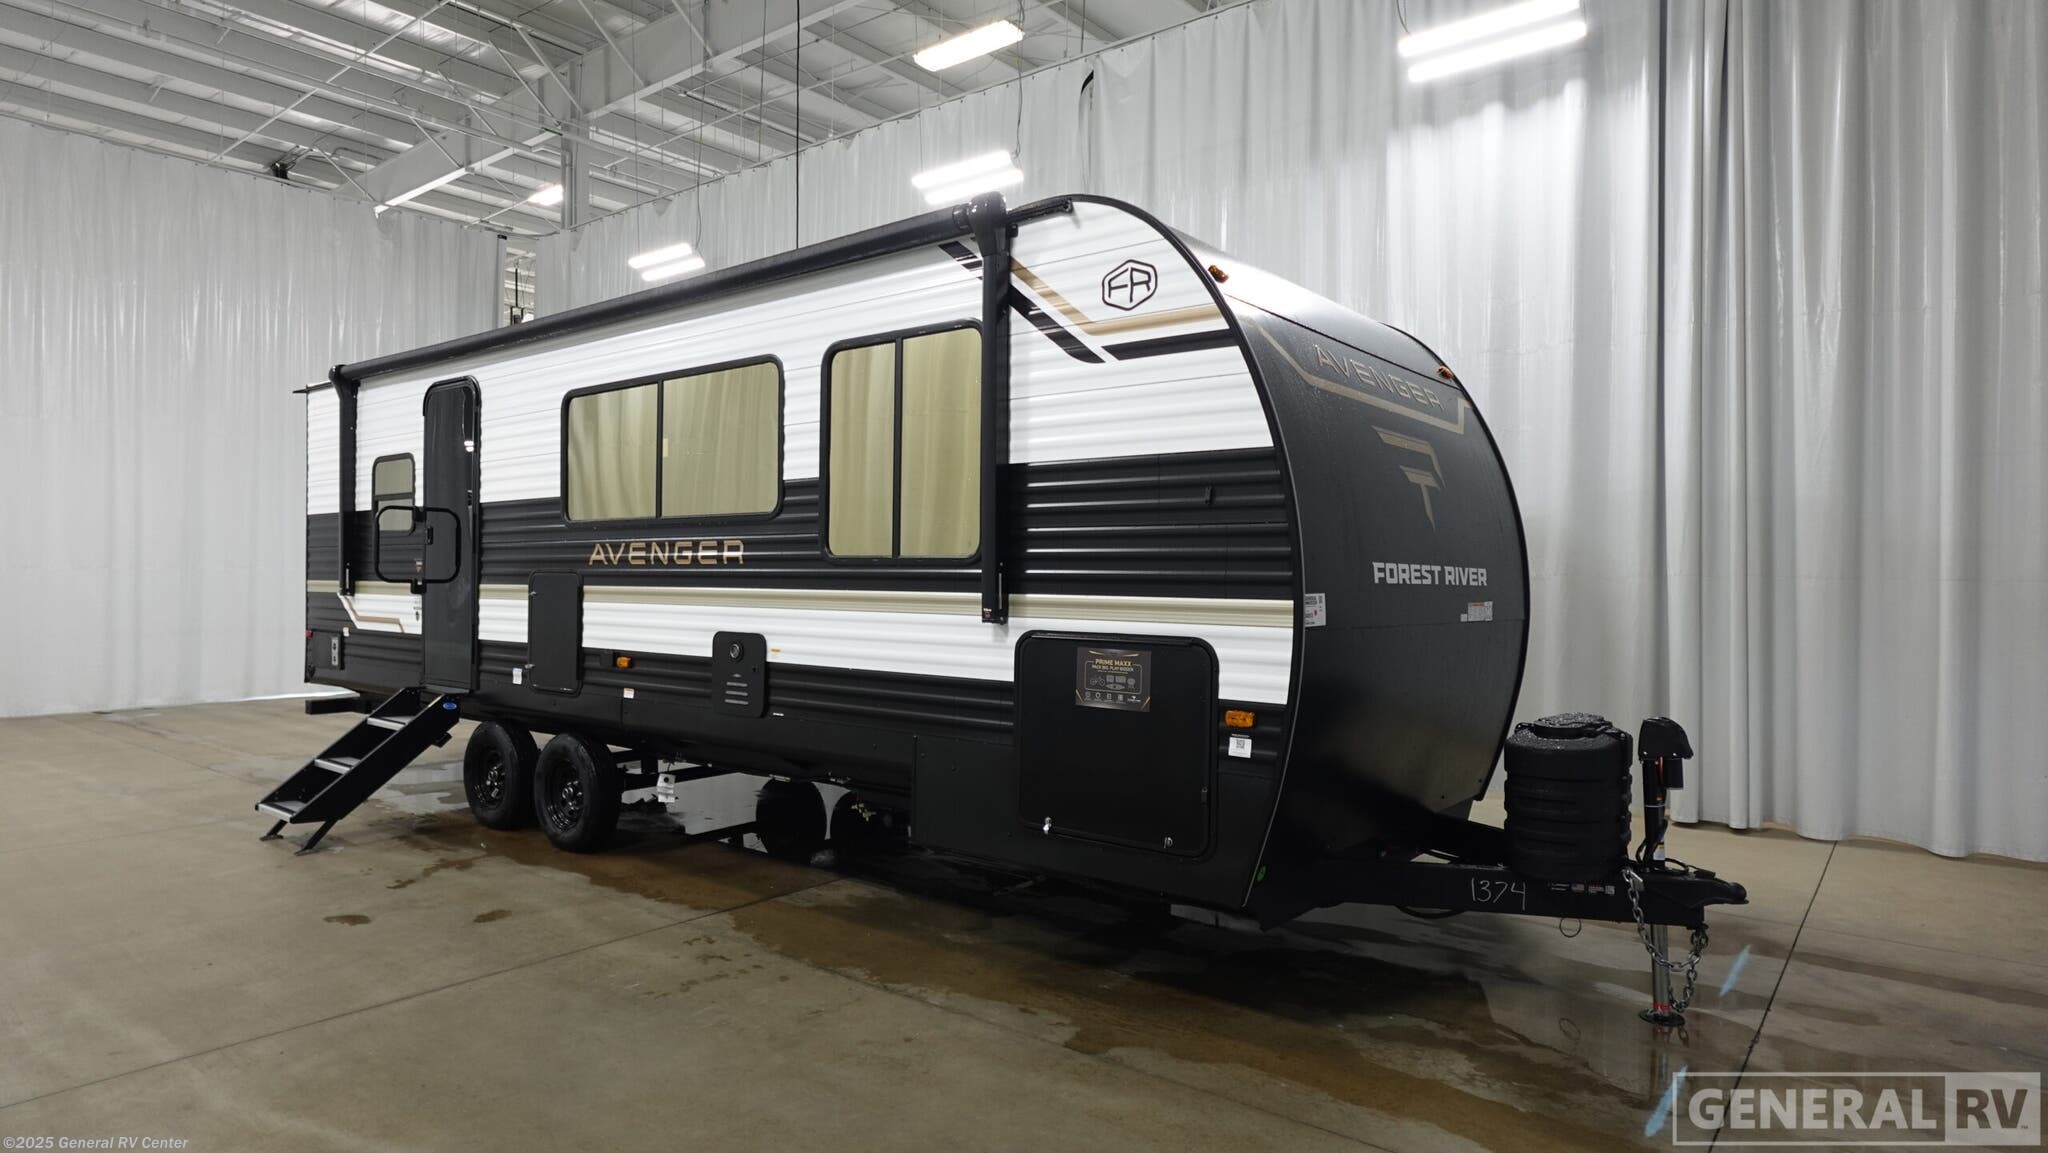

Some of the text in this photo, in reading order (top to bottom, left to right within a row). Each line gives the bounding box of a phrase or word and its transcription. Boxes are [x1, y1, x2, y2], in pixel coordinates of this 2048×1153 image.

[1314, 344, 1444, 411] AVENGER
[588, 540, 745, 566] AVENGER
[1372, 561, 1488, 586] FOREST RIVER
[1471, 877, 1527, 911] 1374
